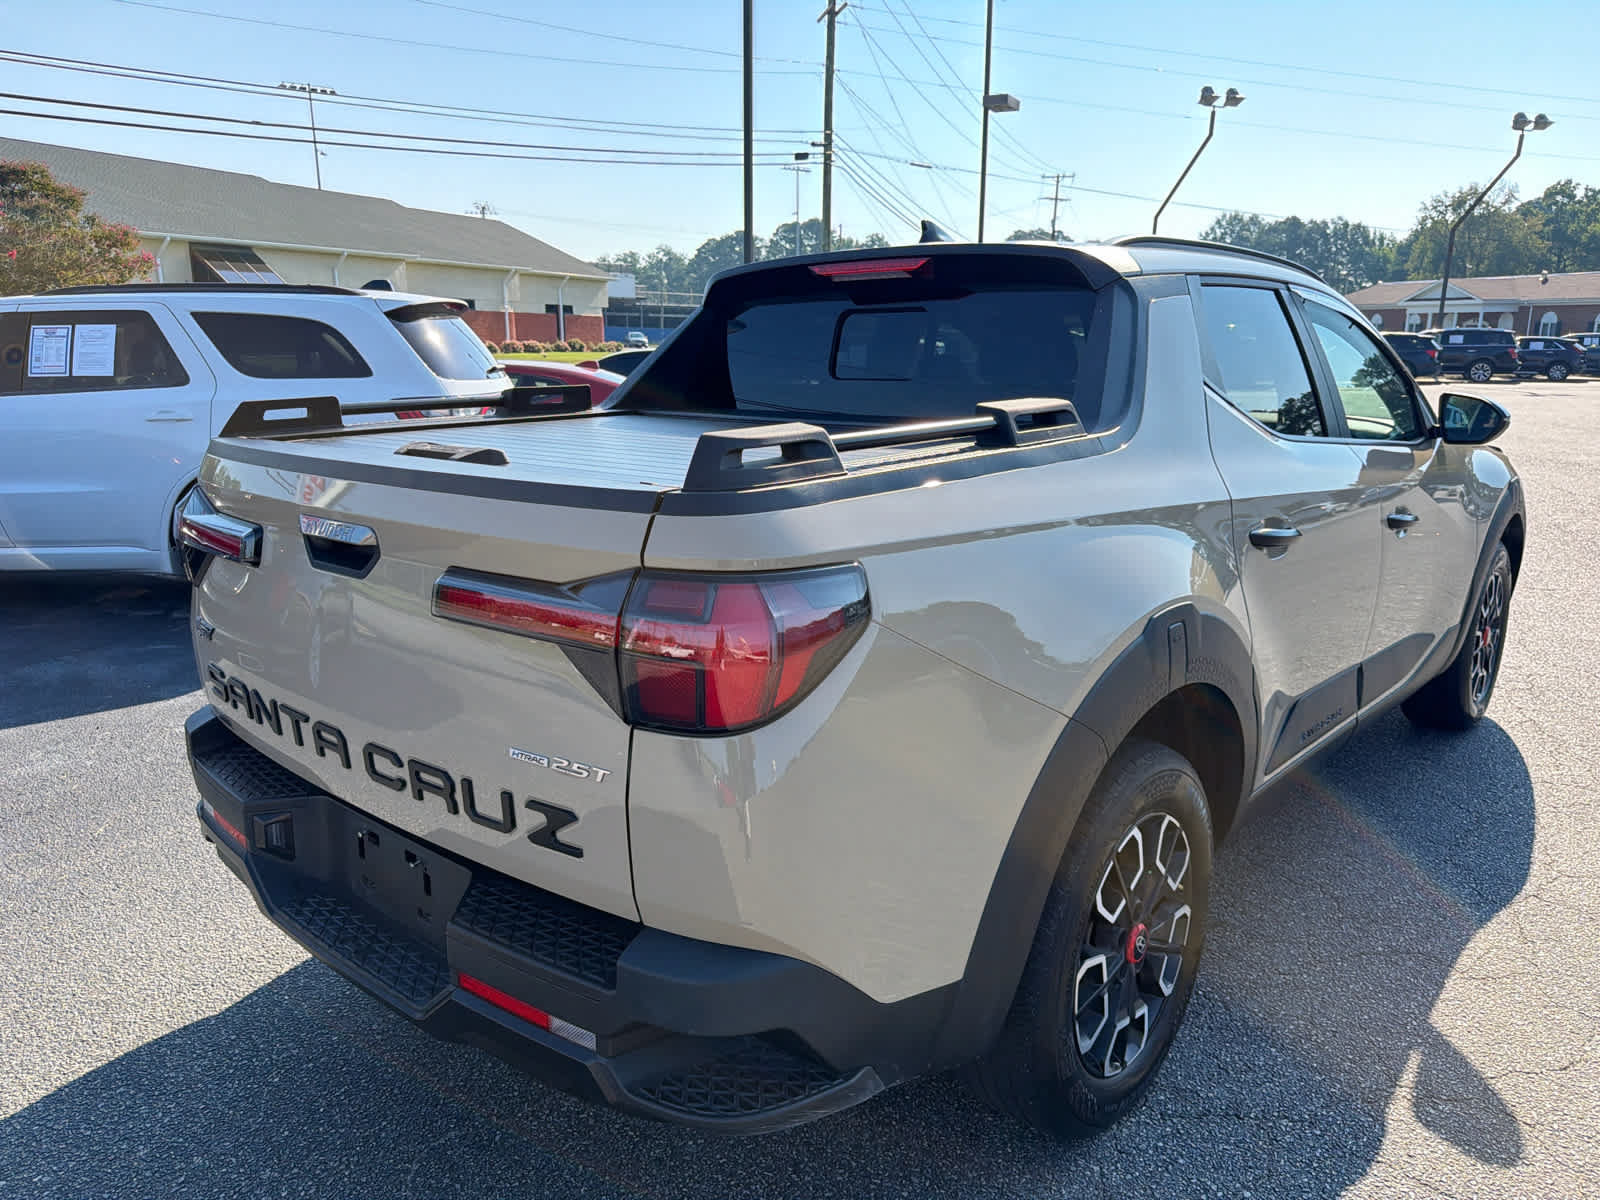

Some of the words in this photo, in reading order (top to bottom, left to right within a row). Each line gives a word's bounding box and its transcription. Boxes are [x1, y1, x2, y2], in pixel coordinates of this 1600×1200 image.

[303, 518, 355, 543] HYUNDAI
[207, 663, 352, 770] SANTA
[362, 741, 584, 859] CRUZ
[511, 750, 546, 766] HTRAC
